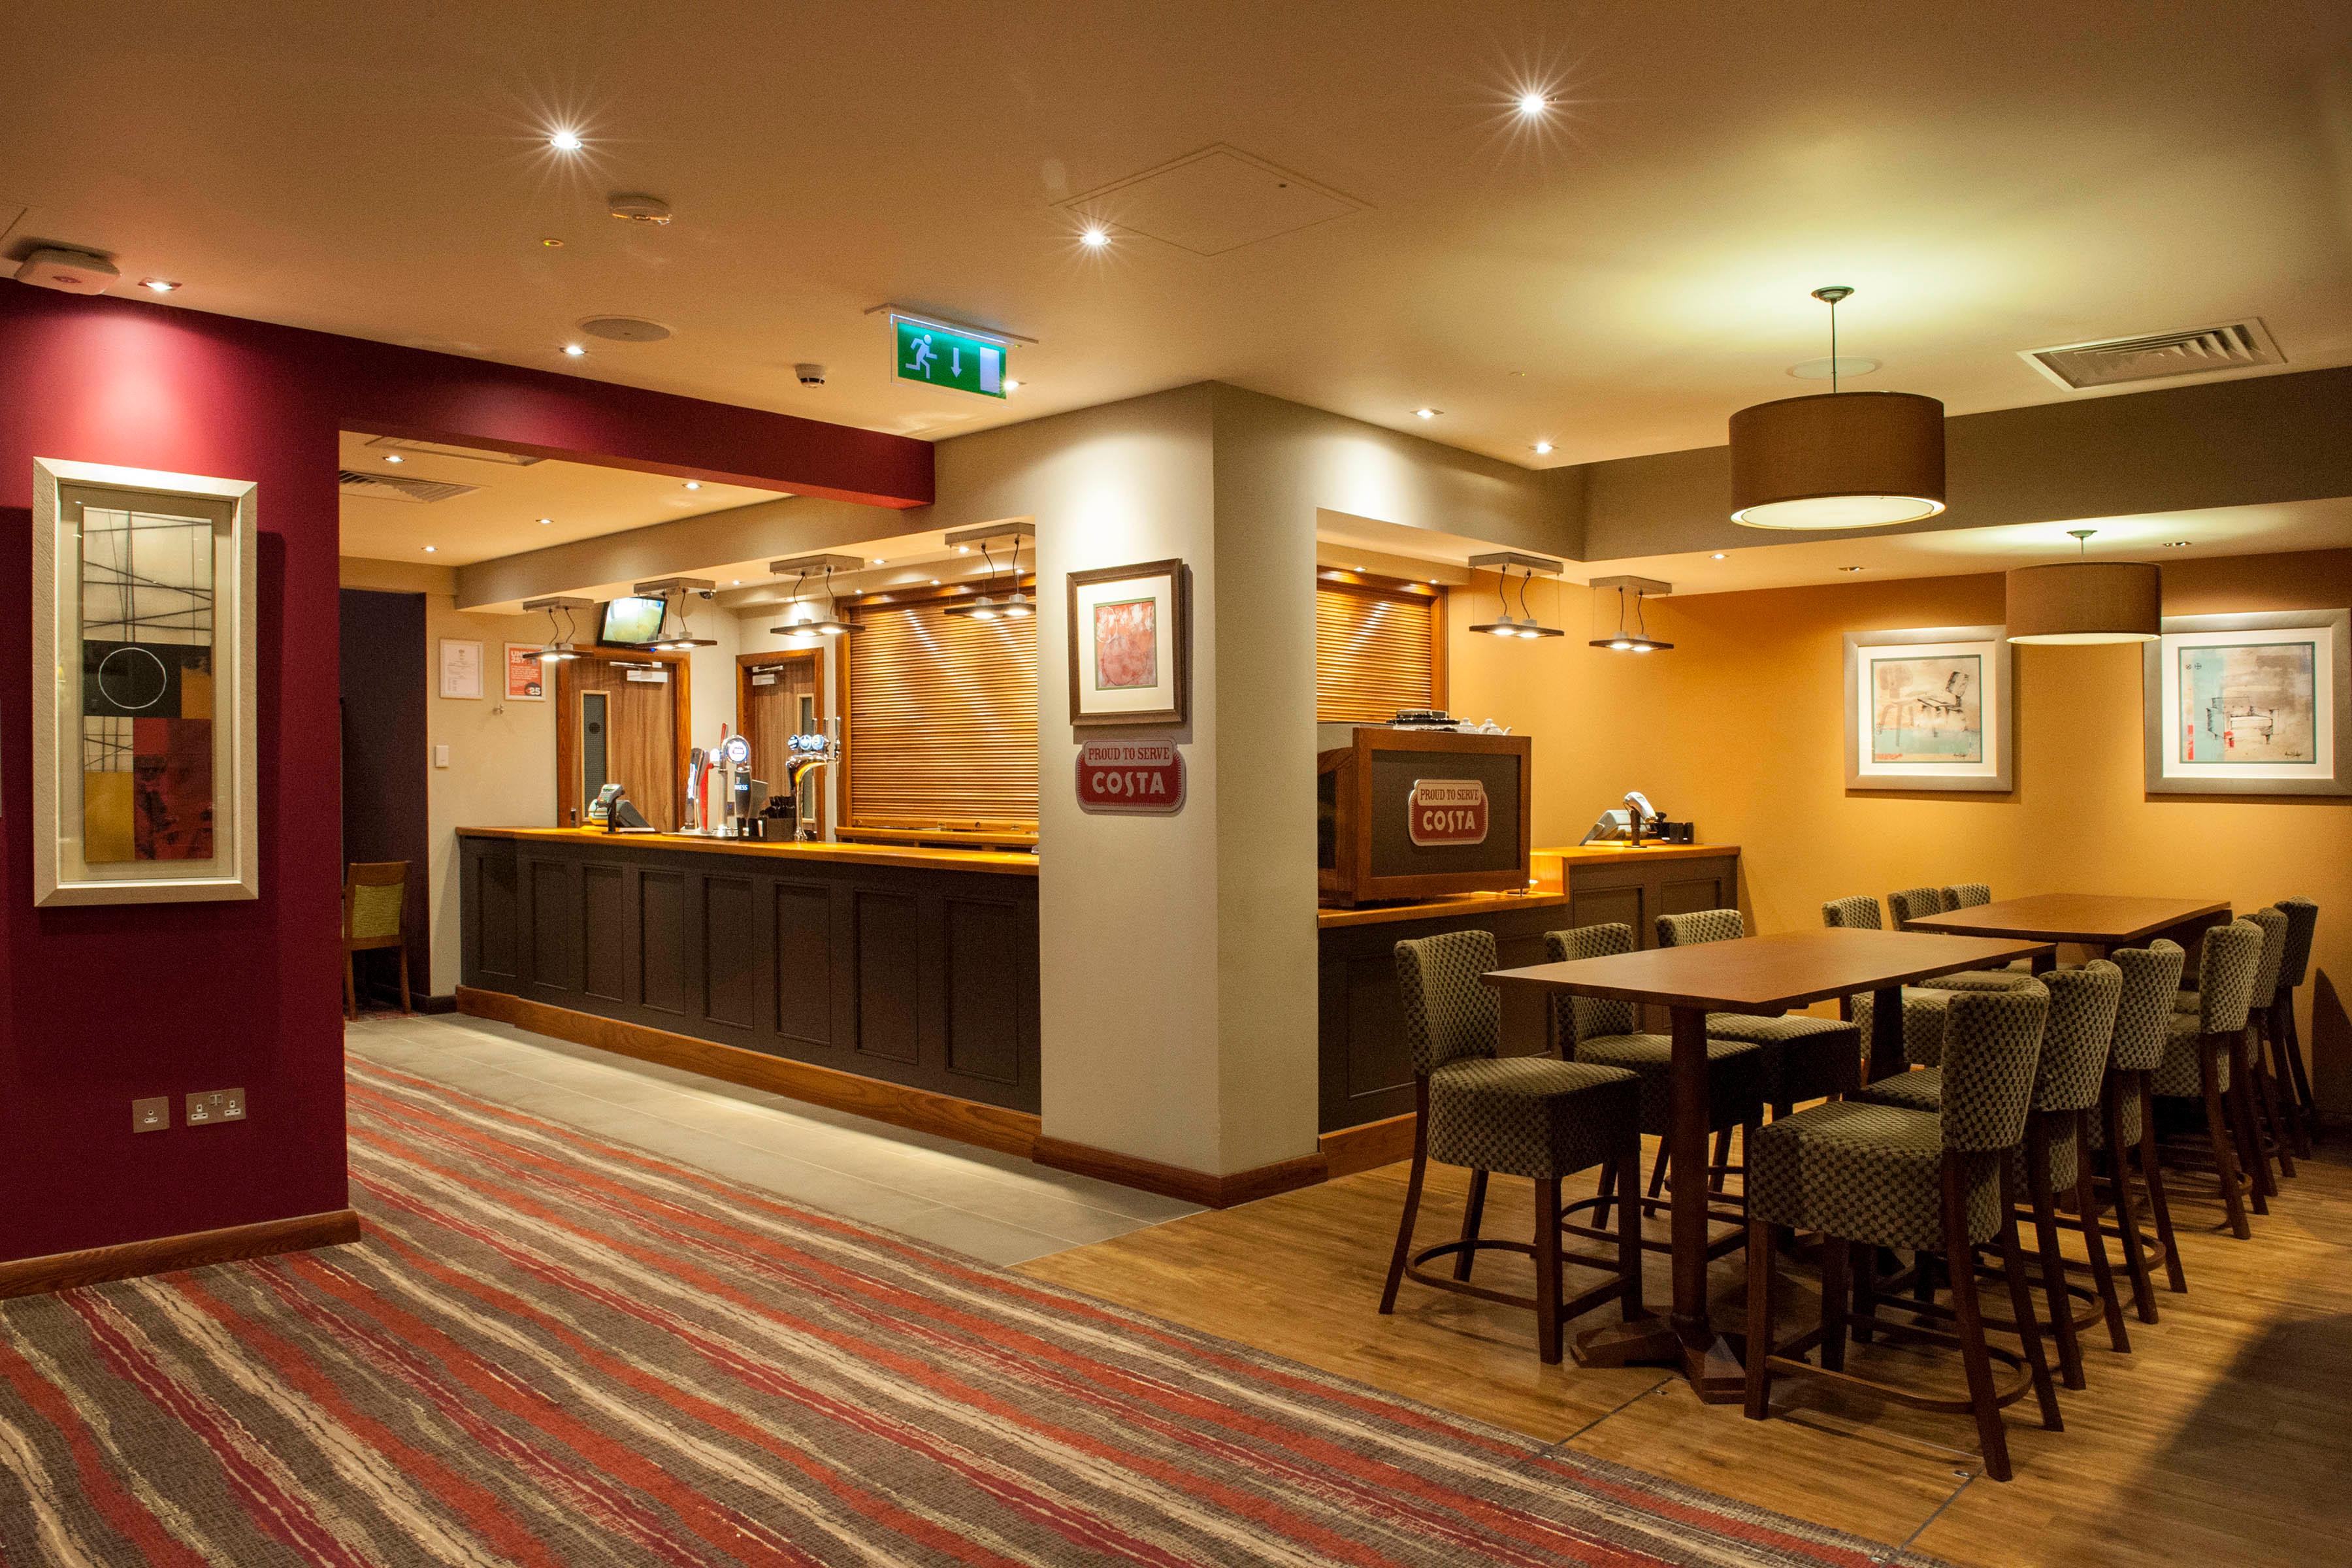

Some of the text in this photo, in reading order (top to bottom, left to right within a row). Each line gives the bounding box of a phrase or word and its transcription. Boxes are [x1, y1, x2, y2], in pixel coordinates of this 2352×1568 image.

[530, 687, 541, 696] 25
[1088, 747, 1169, 760] PROUD TO SERVE
[1092, 771, 1166, 798] COSTA
[1420, 789, 1479, 800] PROUD TO SERVE
[1423, 810, 1475, 833] COSTA
